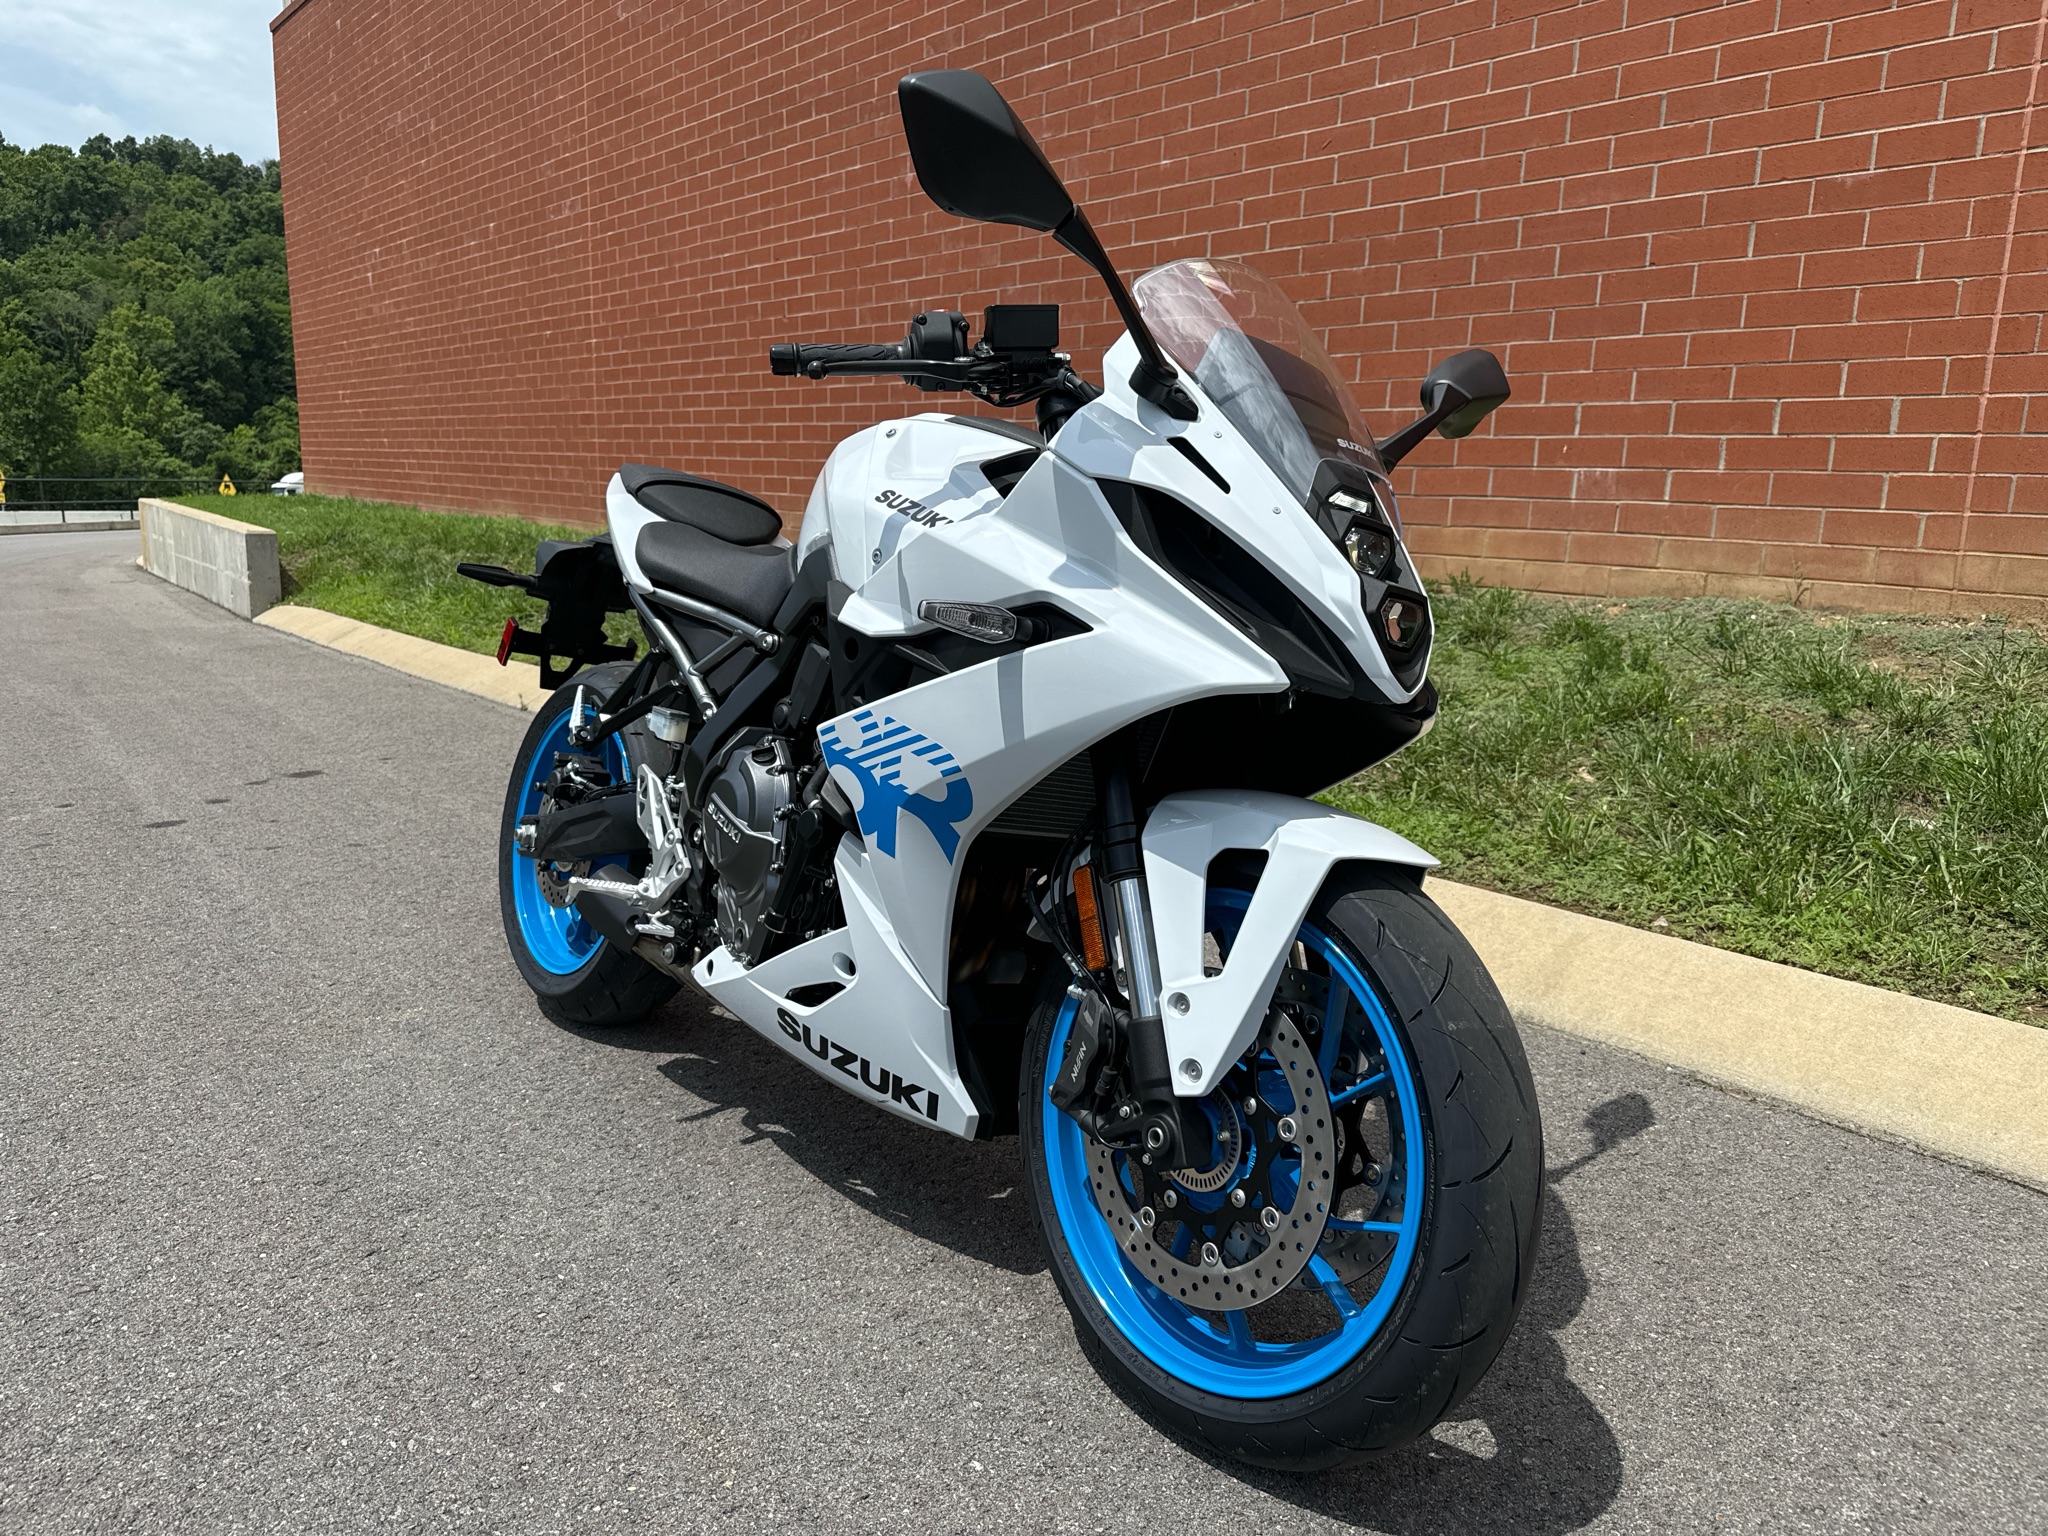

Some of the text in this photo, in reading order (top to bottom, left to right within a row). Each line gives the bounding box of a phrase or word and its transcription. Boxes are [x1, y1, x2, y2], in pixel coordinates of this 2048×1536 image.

[874, 489, 954, 529] SUZUK
[708, 803, 741, 843] SUZUKI
[777, 1007, 939, 1122] SUZUKI
